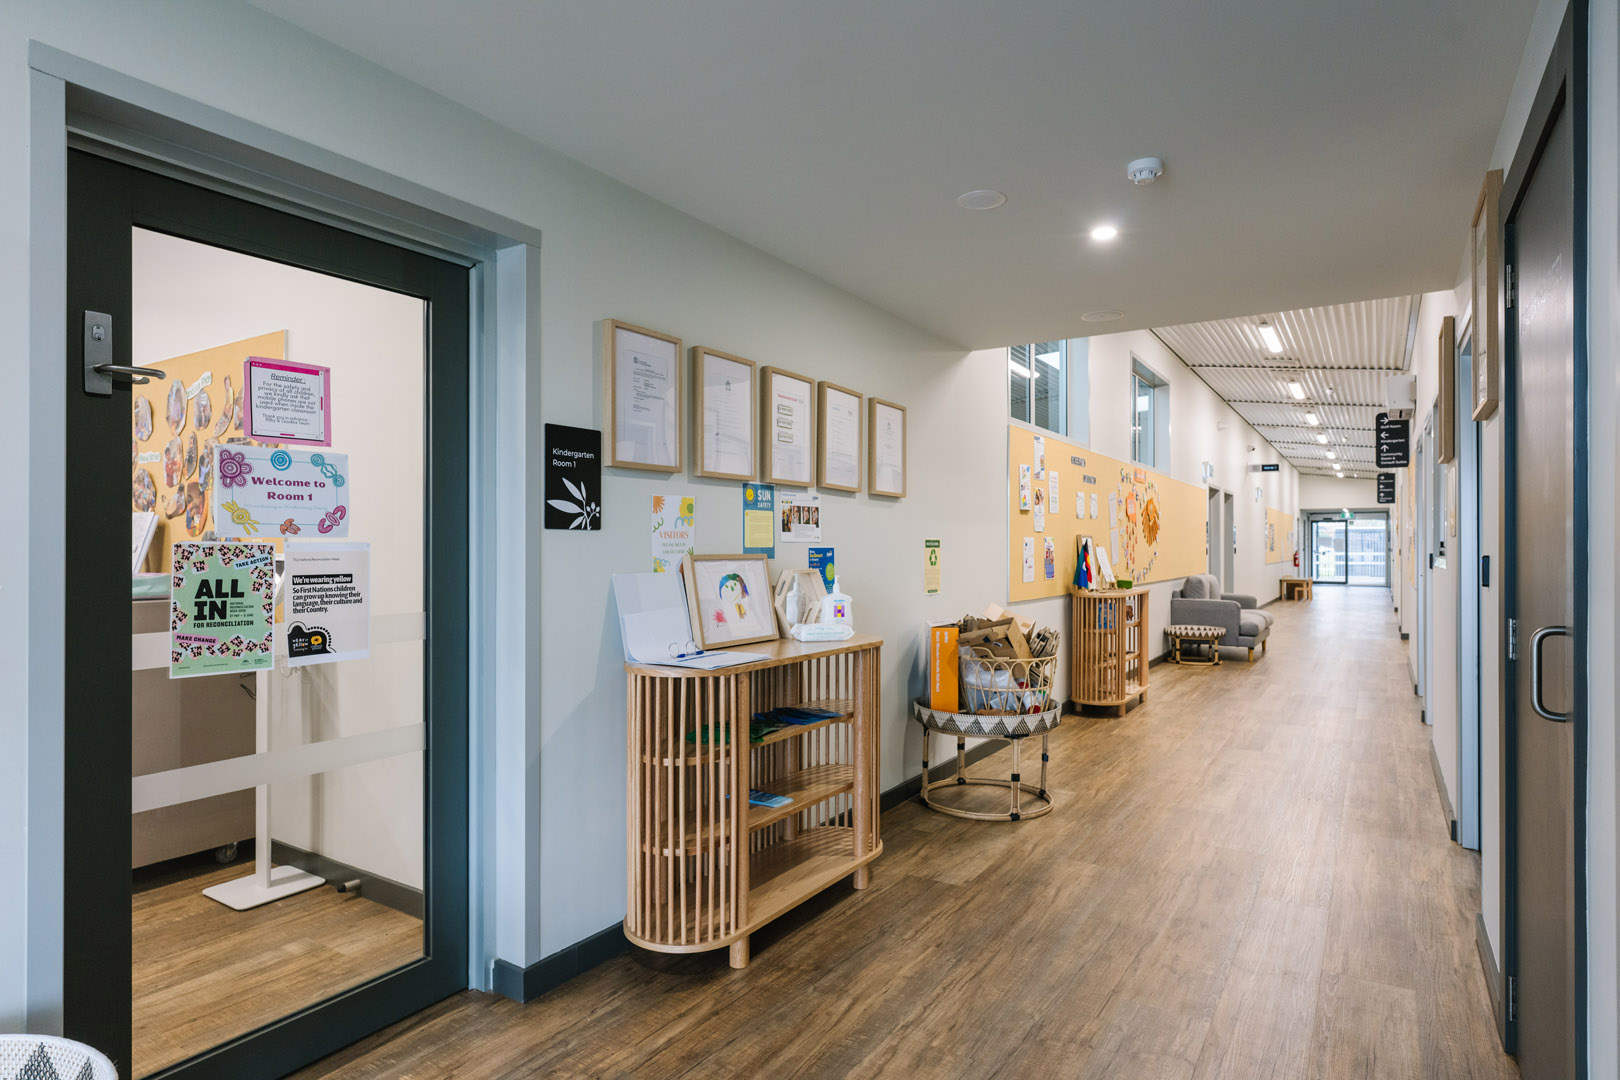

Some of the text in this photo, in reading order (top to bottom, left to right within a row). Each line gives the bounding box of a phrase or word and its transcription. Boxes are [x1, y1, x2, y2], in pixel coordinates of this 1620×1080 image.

[256, 404, 290, 412] kindergarten
[552, 448, 594, 459] Kindergarten
[552, 459, 572, 467] Room
[251, 477, 310, 487] Welcome
[267, 492, 304, 501] Room
[758, 490, 771, 501] SUN
[659, 530, 689, 539] VISITORS
[250, 556, 269, 565] ACTION
[310, 576, 333, 584] wearing
[333, 576, 351, 584] yellow
[194, 579, 244, 599] ALL
[194, 600, 227, 621] IN
